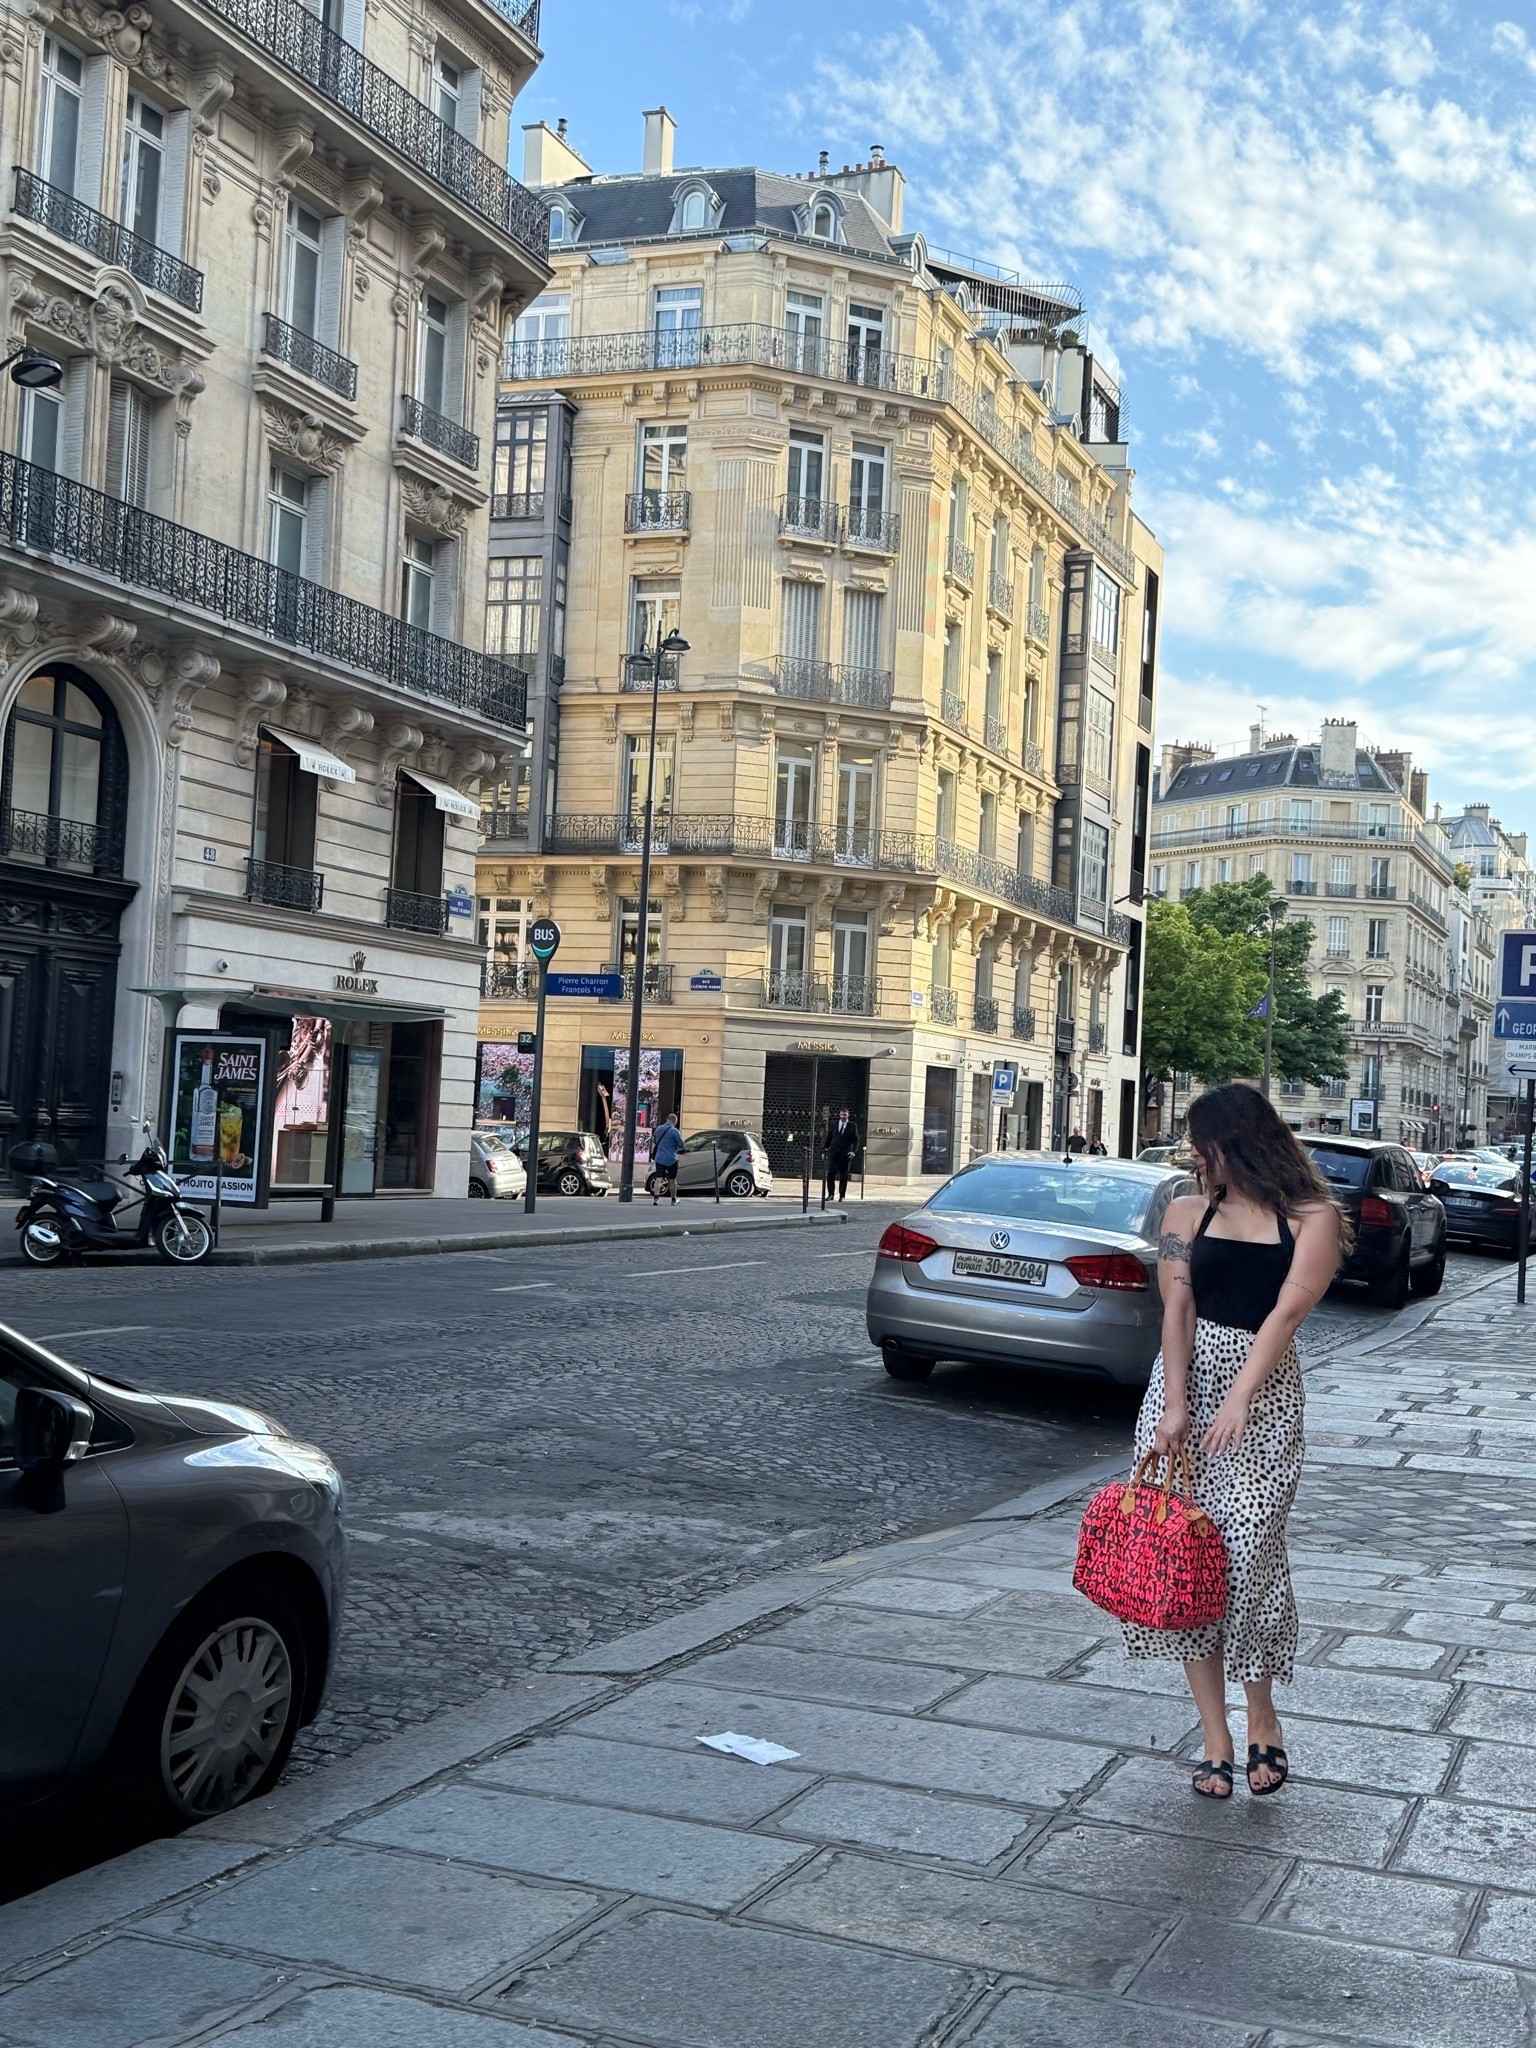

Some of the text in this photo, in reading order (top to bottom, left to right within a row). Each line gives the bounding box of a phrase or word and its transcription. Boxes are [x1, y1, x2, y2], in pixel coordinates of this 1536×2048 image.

[318, 763, 338, 776] ROLEX
[450, 802, 467, 813] ROLEX
[205, 848, 215, 860] 48
[534, 928, 555, 941] BUS
[335, 974, 379, 993] ROLEX
[558, 977, 609, 985] Pierre Charron
[561, 986, 604, 994] François 1er
[477, 1027, 518, 1037] MESSIKA
[611, 1031, 656, 1041] MESKA
[520, 1034, 531, 1044] 32
[797, 1041, 840, 1052] MESSIKA
[218, 1052, 258, 1068] SAINT
[213, 1067, 258, 1080] JAMES
[998, 1073, 1008, 1087] P
[183, 1178, 214, 1189] MOJITO
[220, 1181, 254, 1192] ASSION
[956, 1257, 1043, 1280] KUWAIT 30-27684
